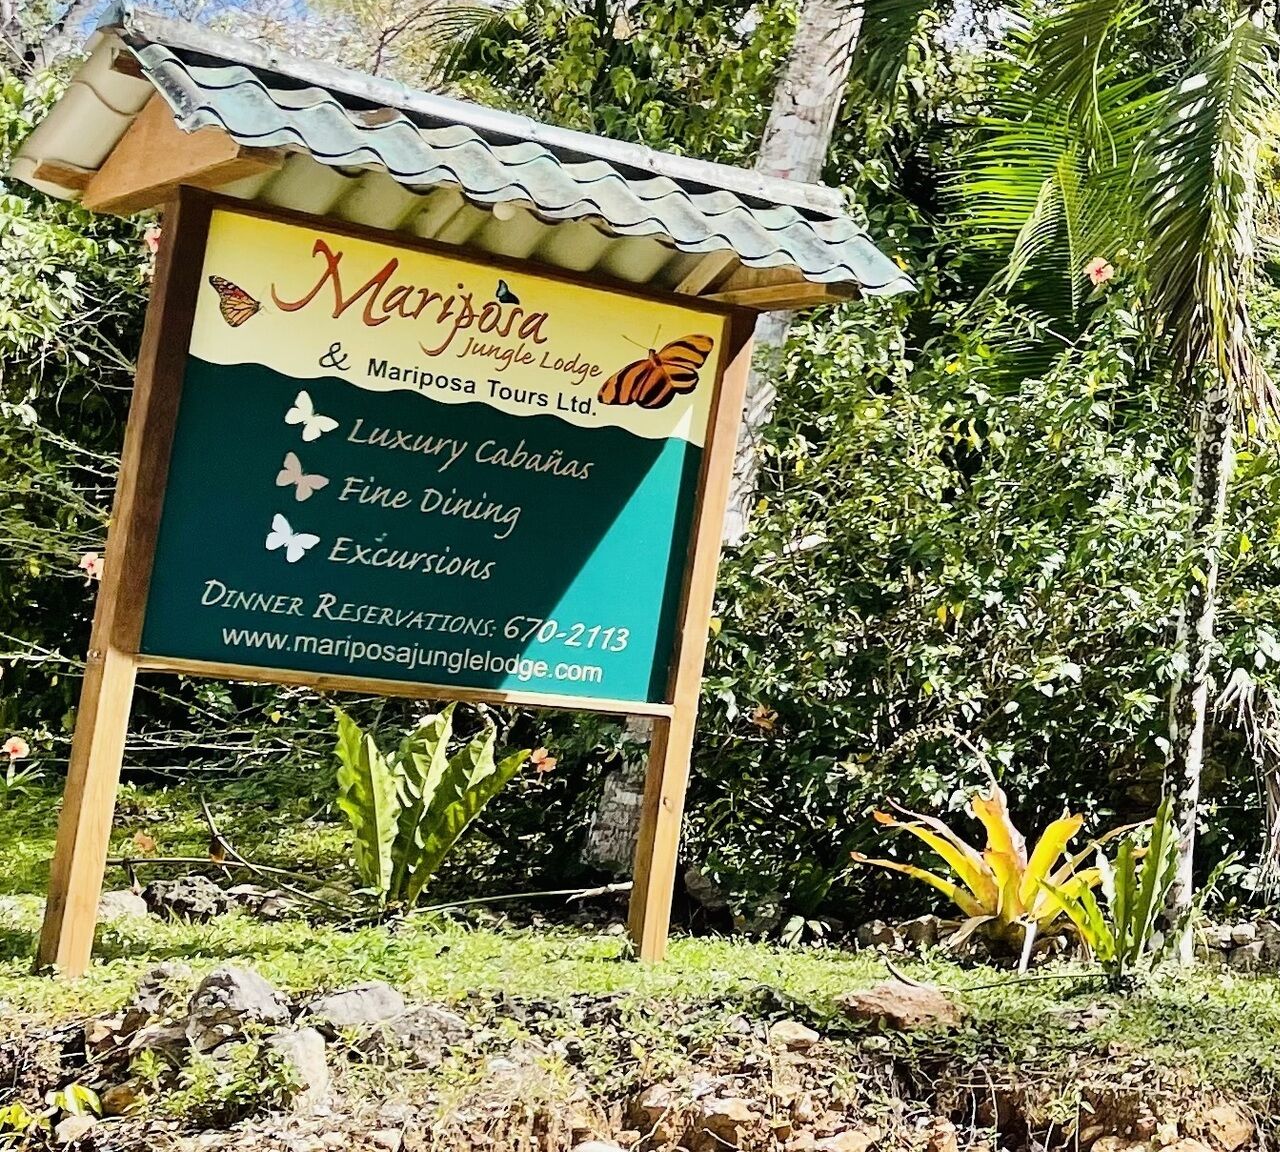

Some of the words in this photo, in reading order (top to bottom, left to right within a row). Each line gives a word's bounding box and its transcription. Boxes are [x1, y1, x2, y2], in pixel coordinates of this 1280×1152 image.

[271, 238, 548, 356] Mariposa
[319, 342, 350, 371] &
[368, 358, 476, 396] Mariposa
[487, 379, 550, 408] Tours
[557, 394, 598, 417] Ltd.
[457, 338, 535, 370] Jungle
[540, 349, 602, 391] Lodge
[348, 419, 467, 472] Luxury
[476, 439, 593, 481] Cabañas
[338, 477, 411, 509] Fine
[420, 487, 521, 539] Dining
[328, 538, 495, 581] Excursions
[222, 627, 603, 683] www.mariposajunglelodge.com
[504, 616, 629, 651] 670-2113
